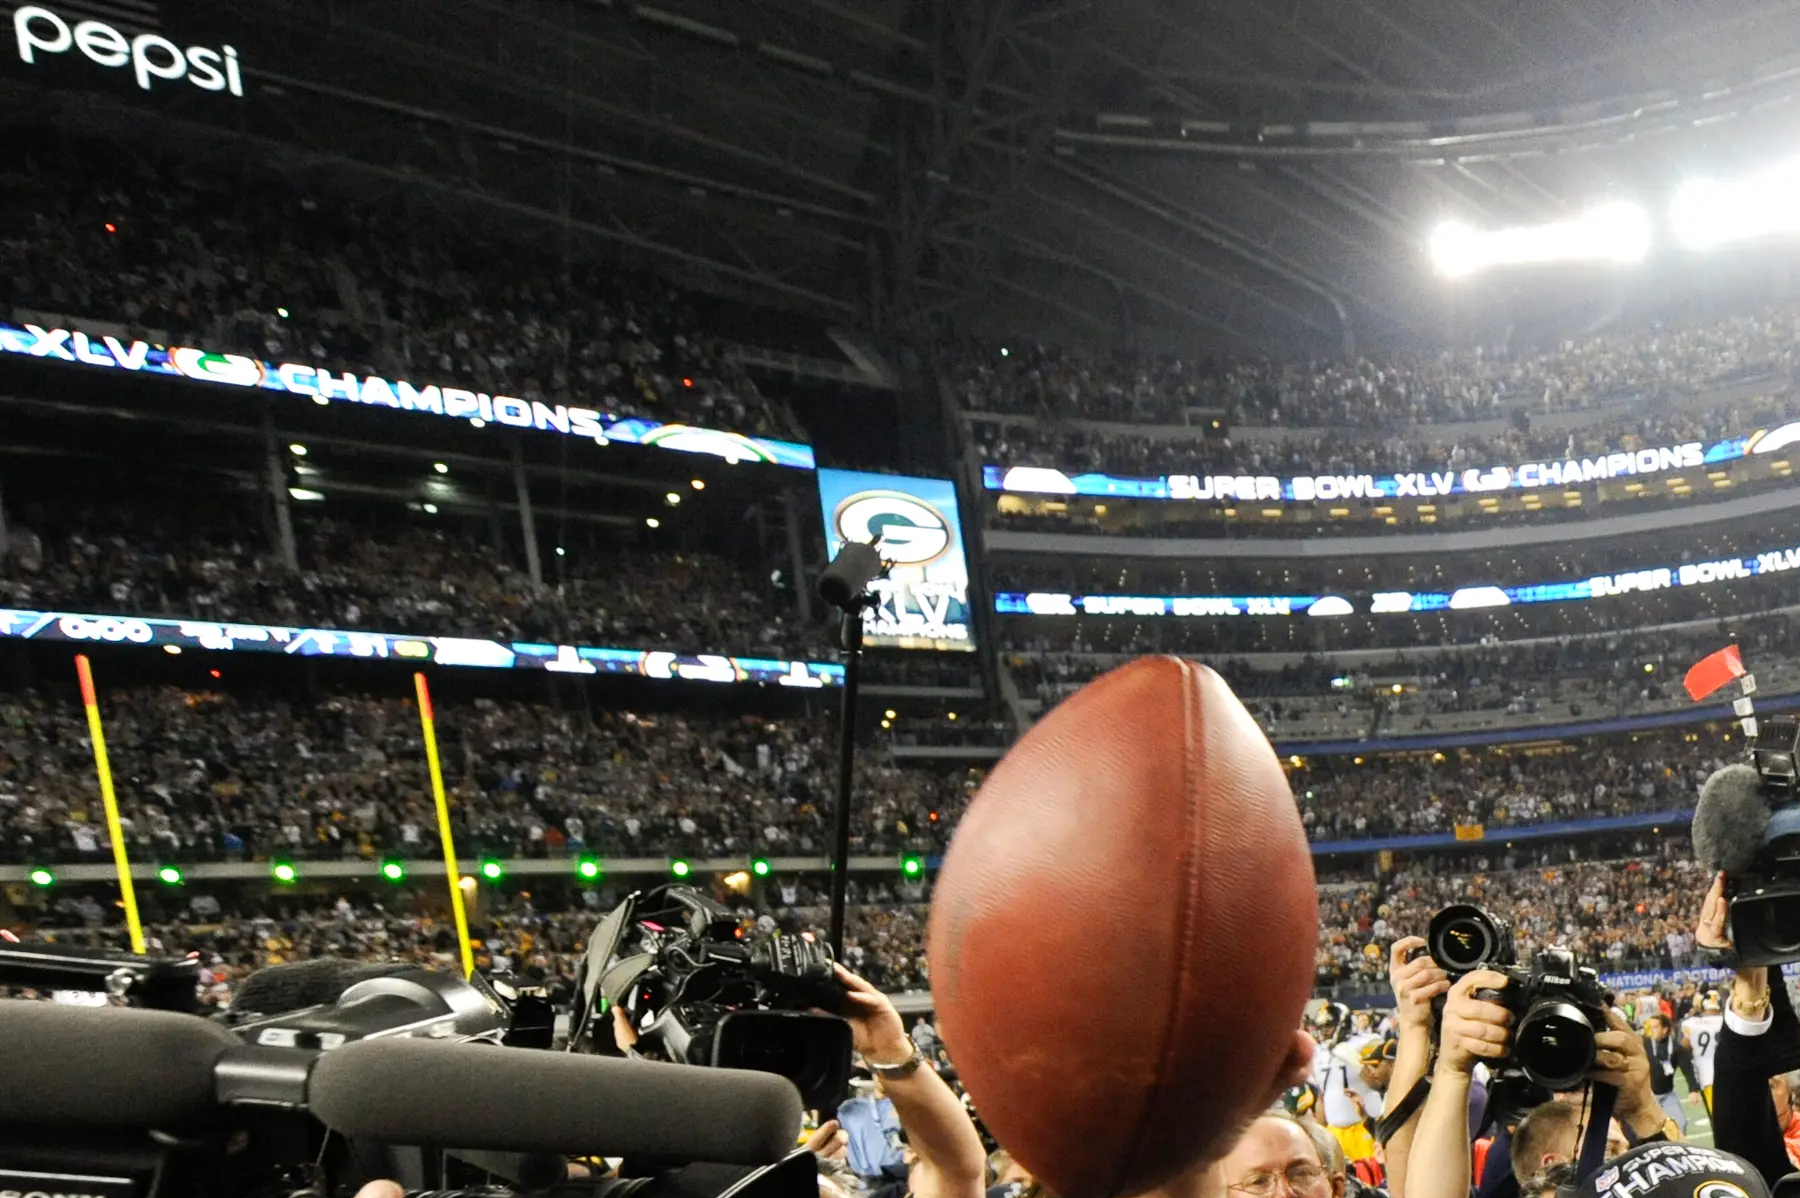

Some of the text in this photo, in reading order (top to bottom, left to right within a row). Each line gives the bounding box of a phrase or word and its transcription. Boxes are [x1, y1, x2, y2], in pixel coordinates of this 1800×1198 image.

[13, 5, 243, 96] pepsi
[24, 324, 149, 370] XLV
[279, 363, 604, 437] CHAMPIONS
[1167, 474, 1279, 500] SUPER
[1292, 474, 1384, 500] BOWL
[1396, 471, 1454, 496] XLV
[1519, 442, 1704, 487] CHAMPIONS
[1589, 568, 1671, 597] SUPER
[1679, 557, 1751, 585] BOWL
[1083, 596, 1291, 616] SUPER BOWL XLV
[1543, 975, 1571, 985] Nikon
[1606, 967, 1736, 990] NATIONAL FOOTBA
[1622, 1146, 1687, 1173] SUPER
